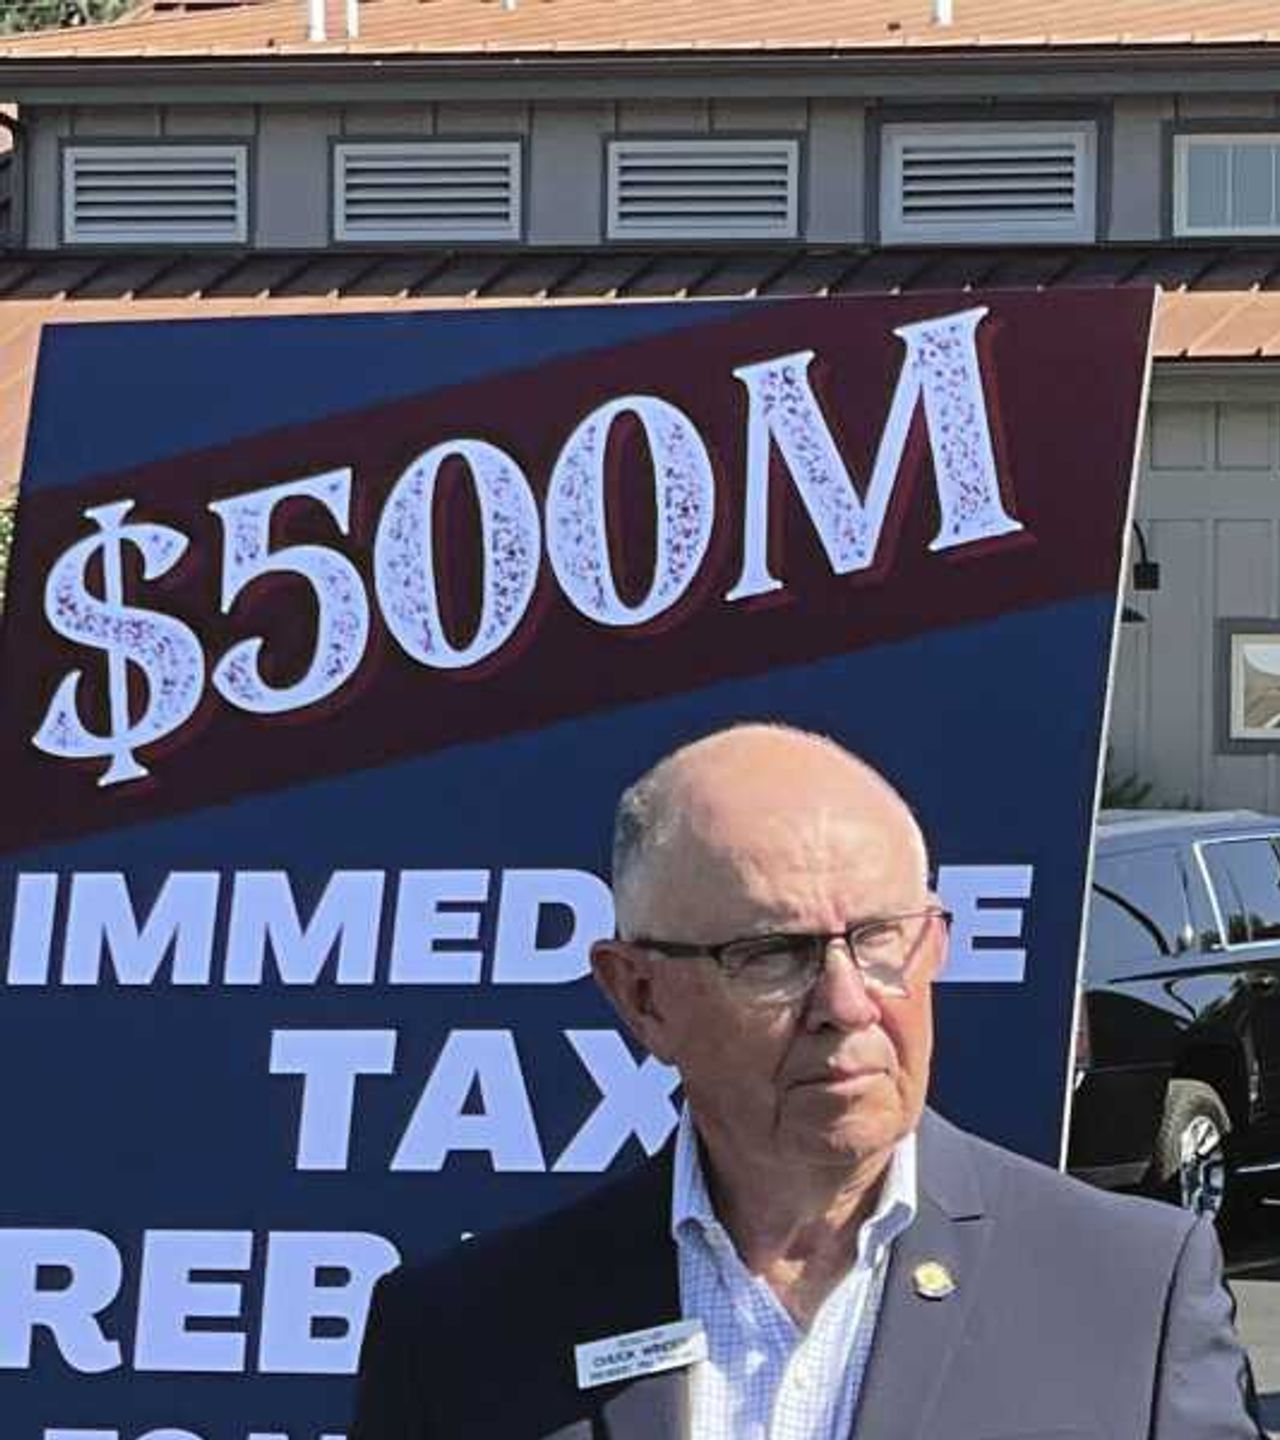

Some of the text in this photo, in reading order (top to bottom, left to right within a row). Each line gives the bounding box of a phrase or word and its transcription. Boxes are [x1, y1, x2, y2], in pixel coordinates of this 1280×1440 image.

[31, 306, 1024, 787] $500M
[6, 864, 1034, 986] IMMEDE
[268, 1029, 683, 1173] TAX
